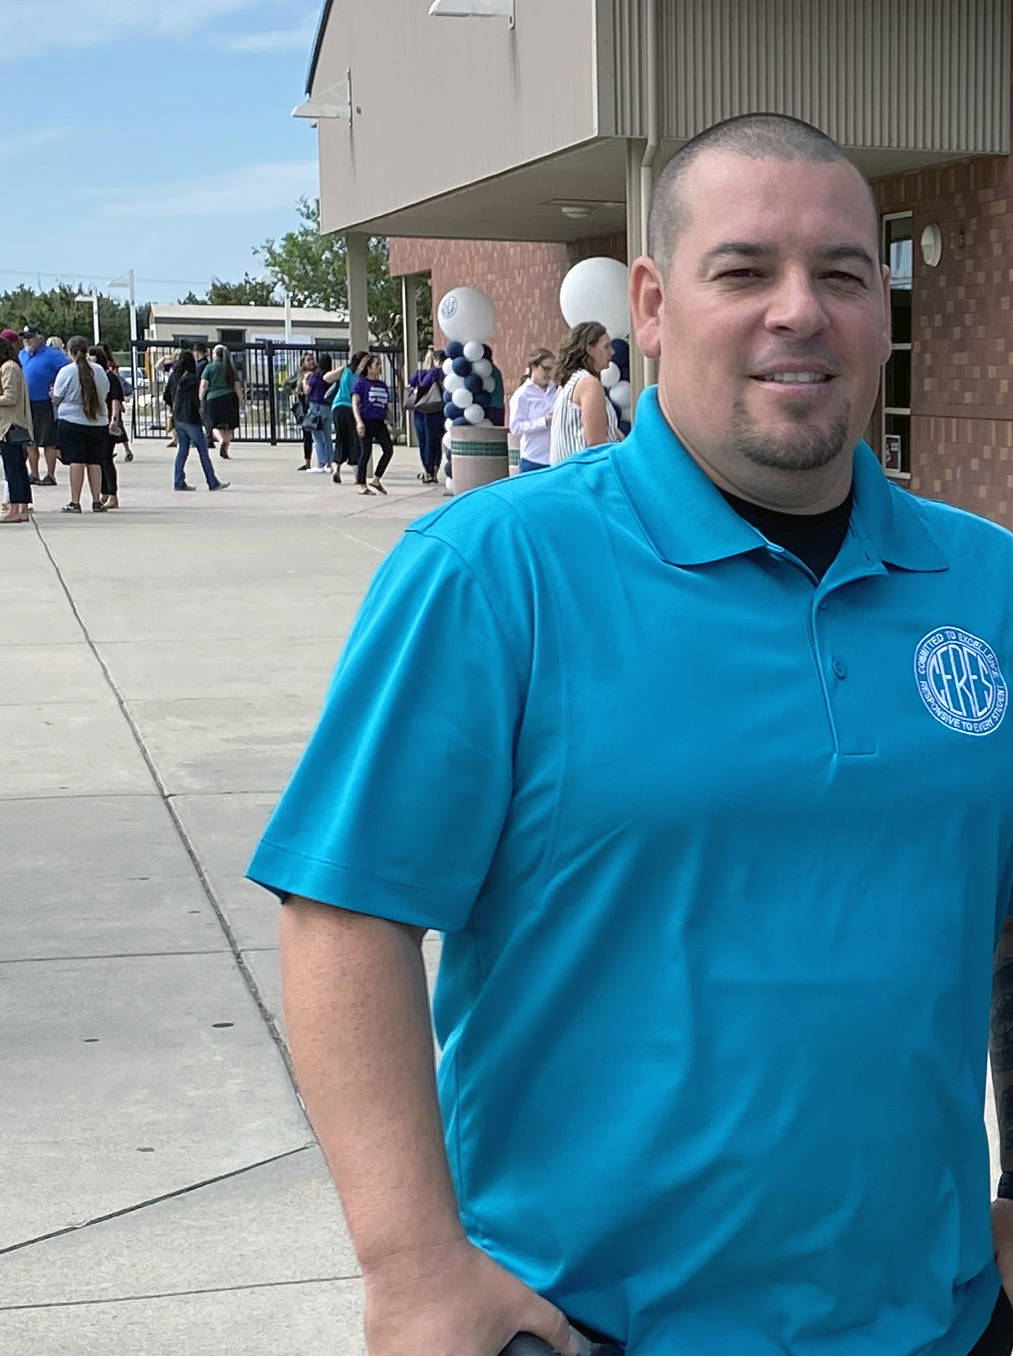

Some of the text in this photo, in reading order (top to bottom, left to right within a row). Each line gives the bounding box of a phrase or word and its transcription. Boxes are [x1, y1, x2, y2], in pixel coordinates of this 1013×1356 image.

[944, 630, 957, 640] TO
[929, 643, 993, 718] CERES
[961, 720, 973, 731] TO
